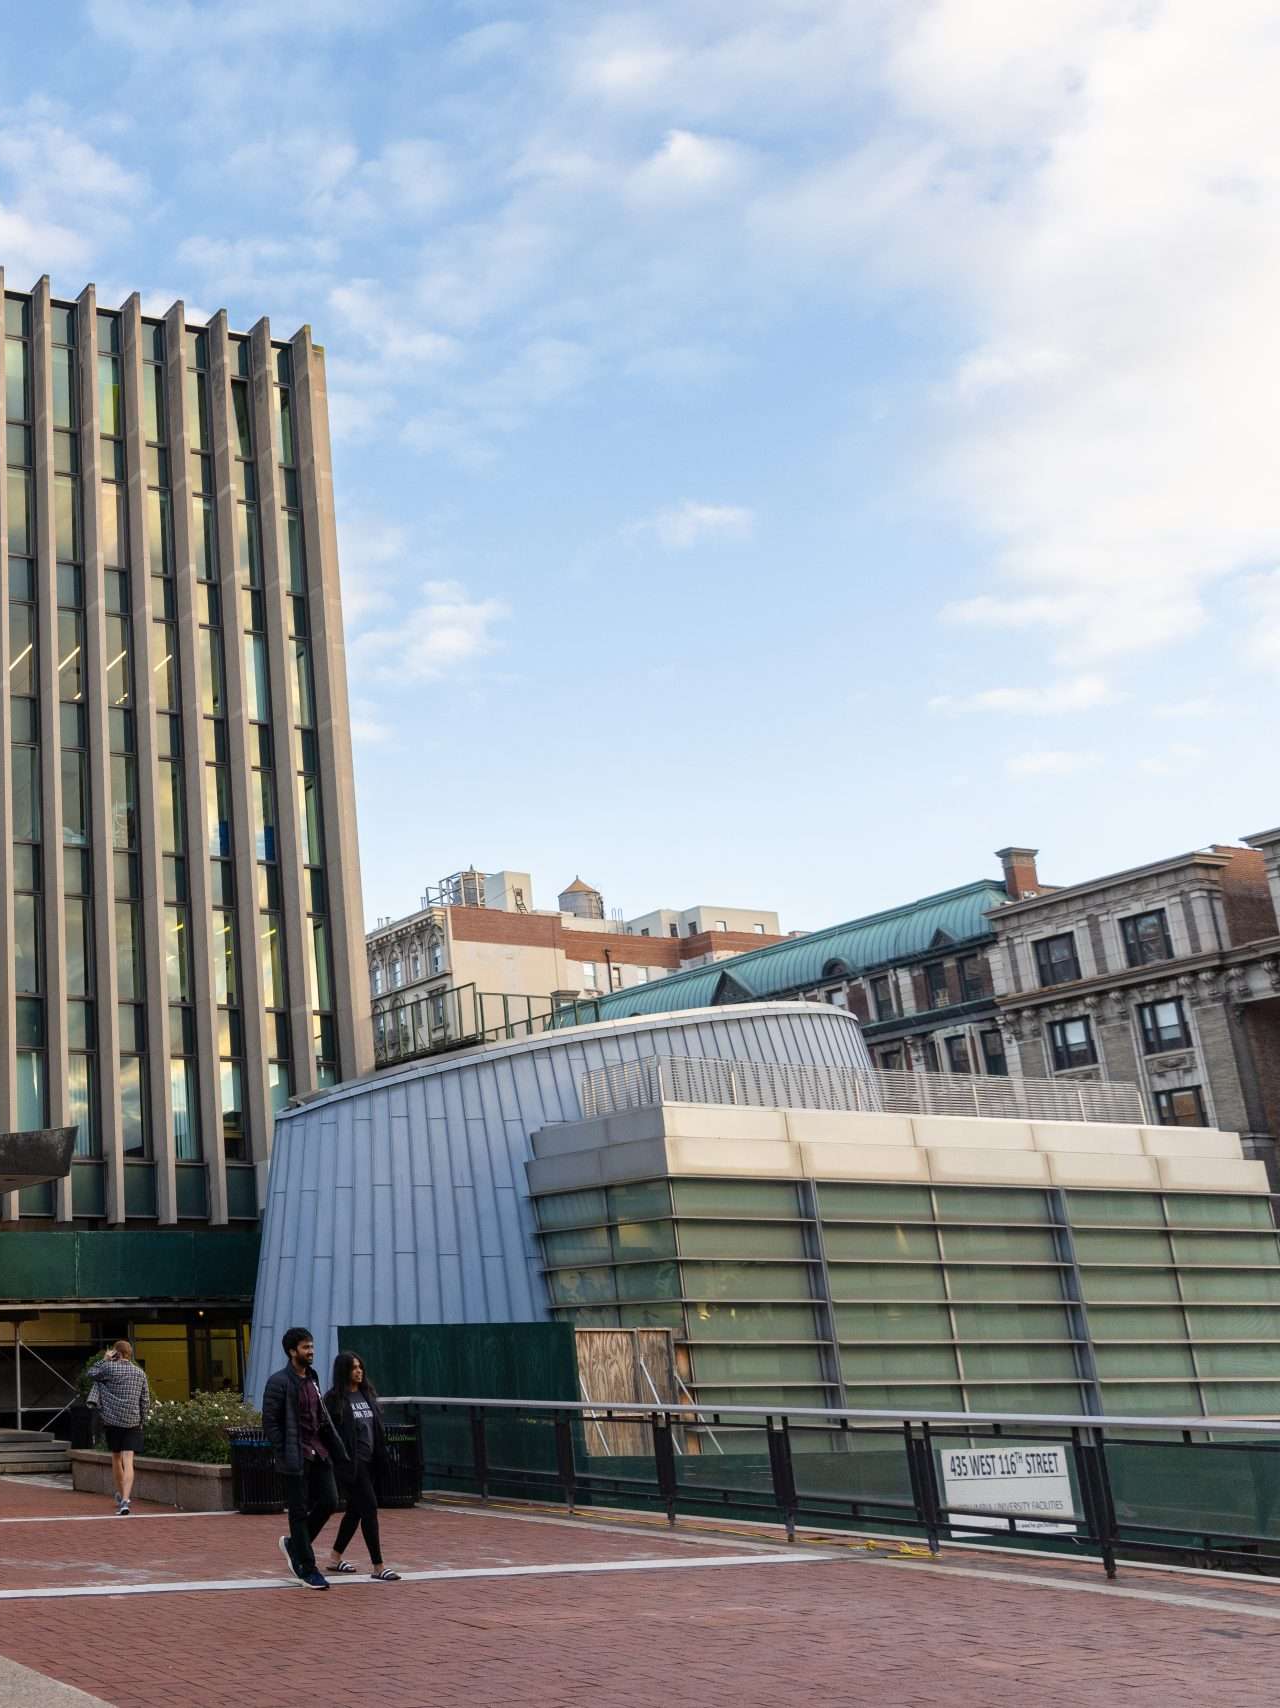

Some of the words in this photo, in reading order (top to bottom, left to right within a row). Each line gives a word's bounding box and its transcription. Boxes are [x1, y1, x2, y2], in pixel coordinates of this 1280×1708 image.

[950, 1456, 969, 1476] 435
[970, 1454, 997, 1476] WEST
[1025, 1453, 1059, 1474] STREET
[1032, 1500, 1064, 1510] FACILITIES
